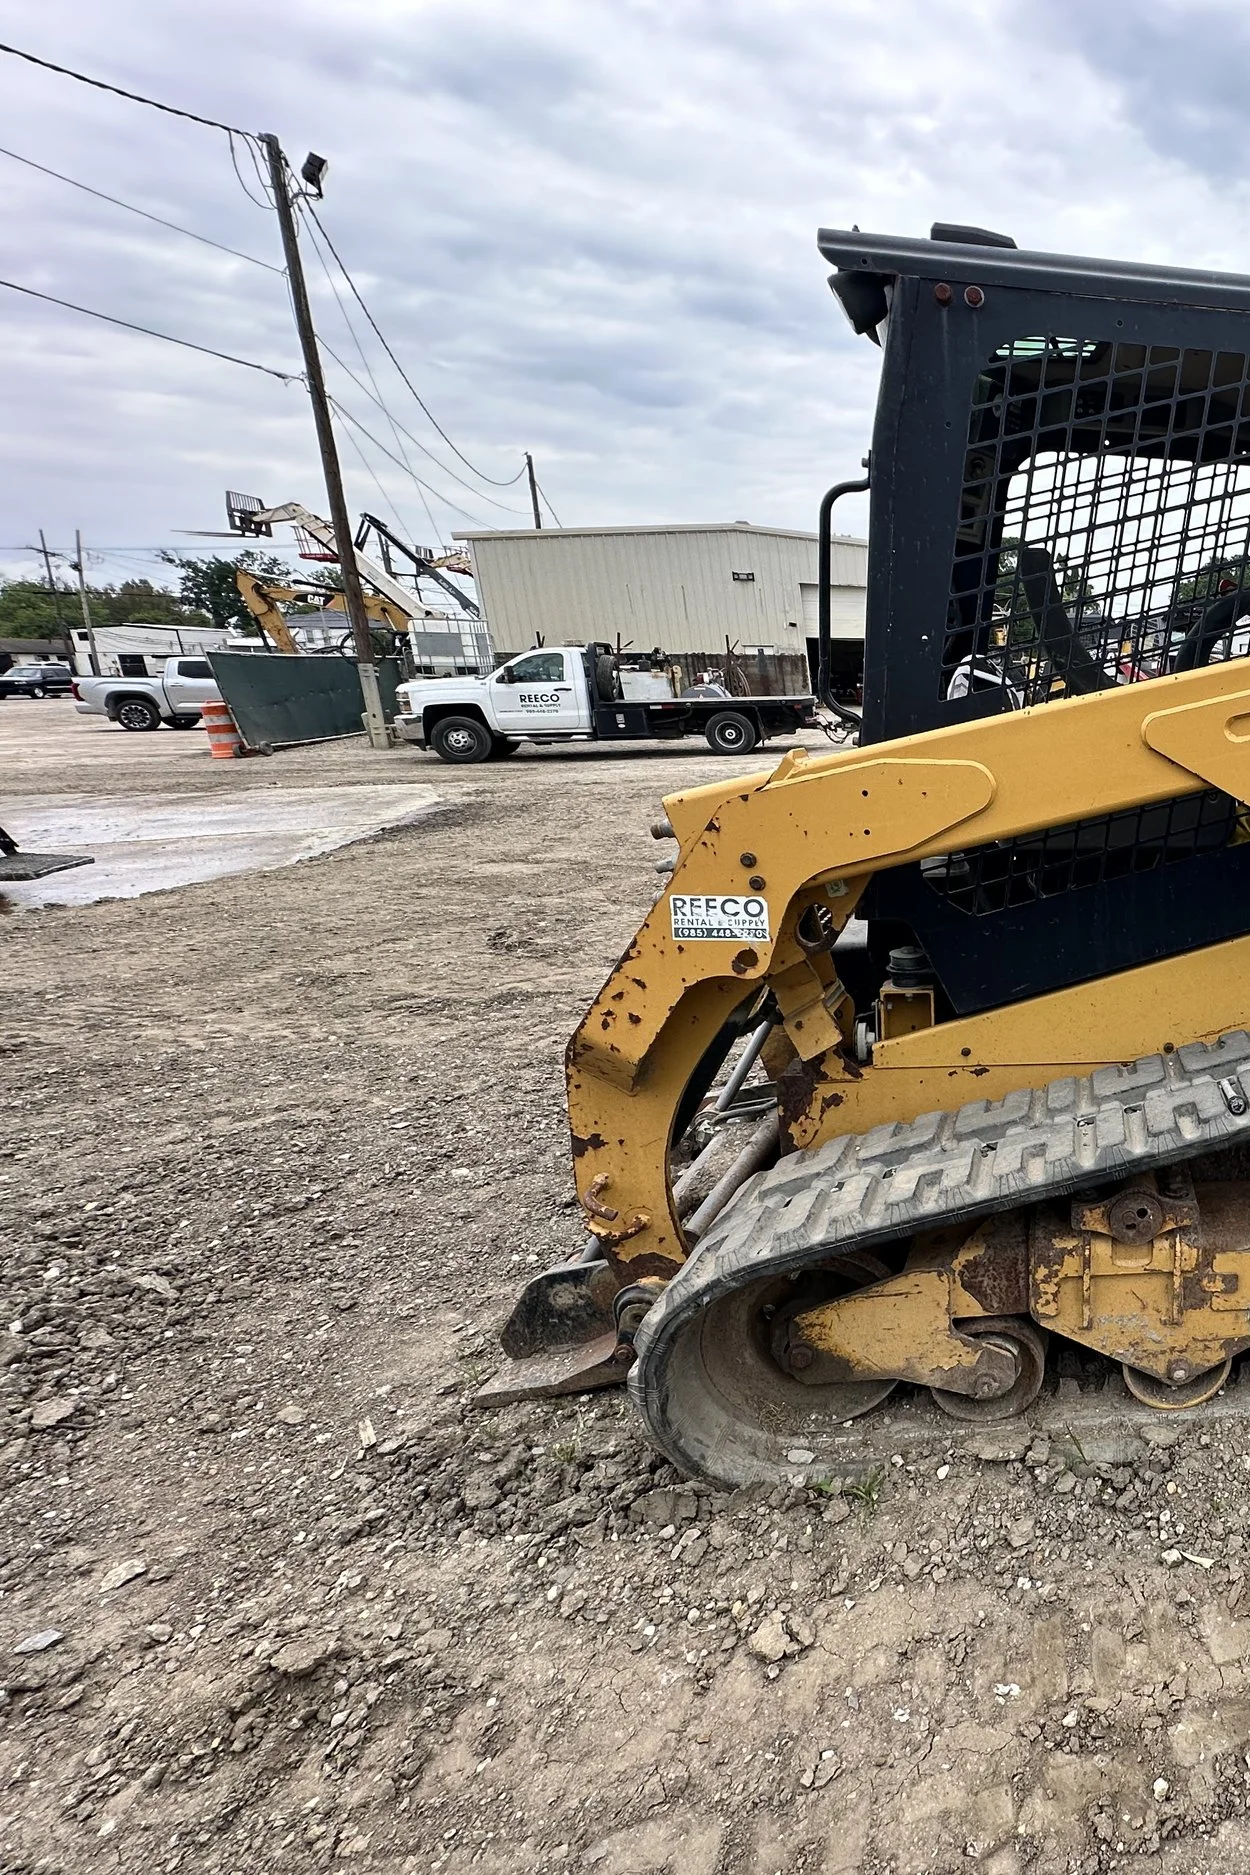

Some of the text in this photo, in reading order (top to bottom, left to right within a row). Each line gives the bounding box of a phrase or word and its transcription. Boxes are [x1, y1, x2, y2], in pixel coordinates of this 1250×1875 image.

[307, 594, 326, 606] CAT
[519, 693, 560, 703] REECO
[672, 897, 765, 918] REECO
[673, 918, 714, 927] RENTAL
[678, 928, 763, 938] (985) 448-2270
